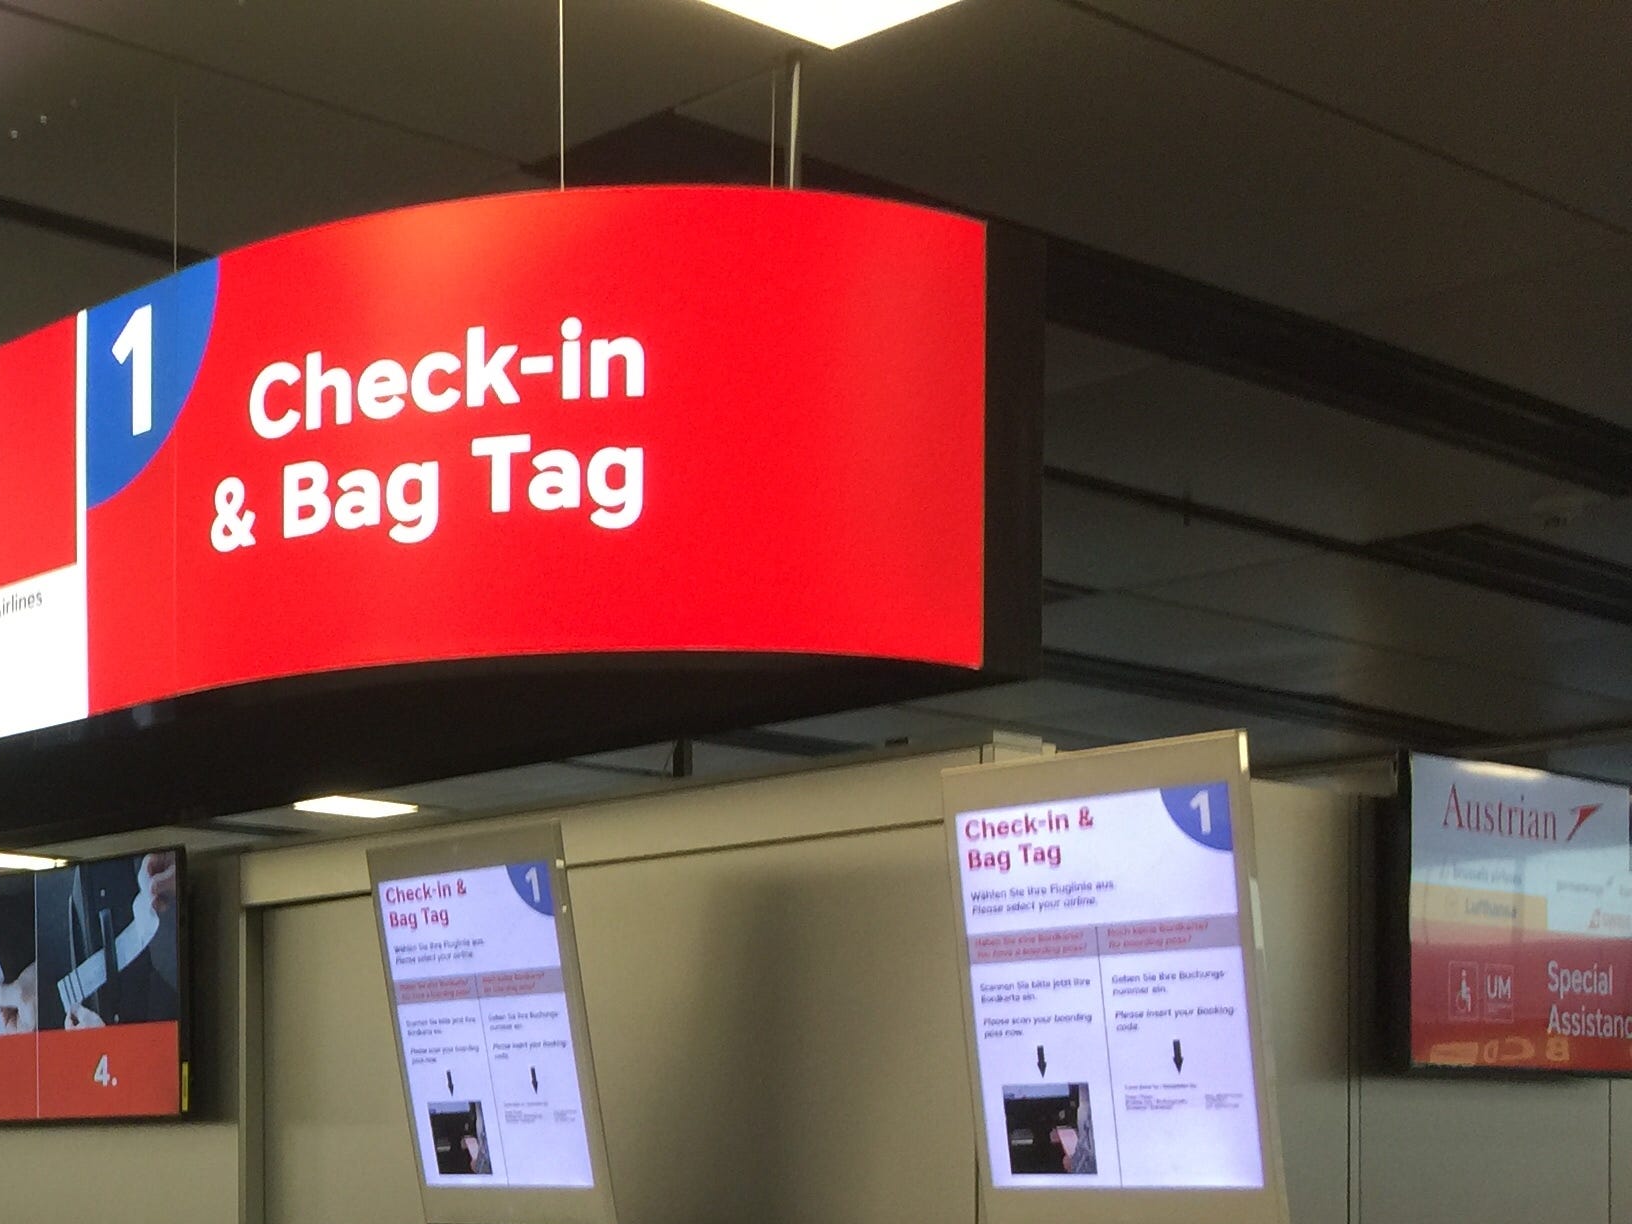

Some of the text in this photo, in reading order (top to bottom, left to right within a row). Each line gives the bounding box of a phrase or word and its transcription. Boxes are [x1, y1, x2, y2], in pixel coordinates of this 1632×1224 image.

[111, 302, 153, 437] 1
[248, 317, 646, 440] Check-in
[210, 432, 645, 553] & Bag Tag
[964, 806, 1095, 842] Check-in &
[1189, 789, 1212, 836] 1
[1442, 783, 1558, 842] Austrian
[967, 842, 1062, 872] Bag Tag
[385, 877, 468, 905] Check-in &
[524, 866, 541, 904] 1
[388, 905, 450, 930] Bag Tag
[1486, 975, 1512, 1000] UM
[1547, 960, 1614, 1000] Special
[92, 1054, 118, 1087] 4.
